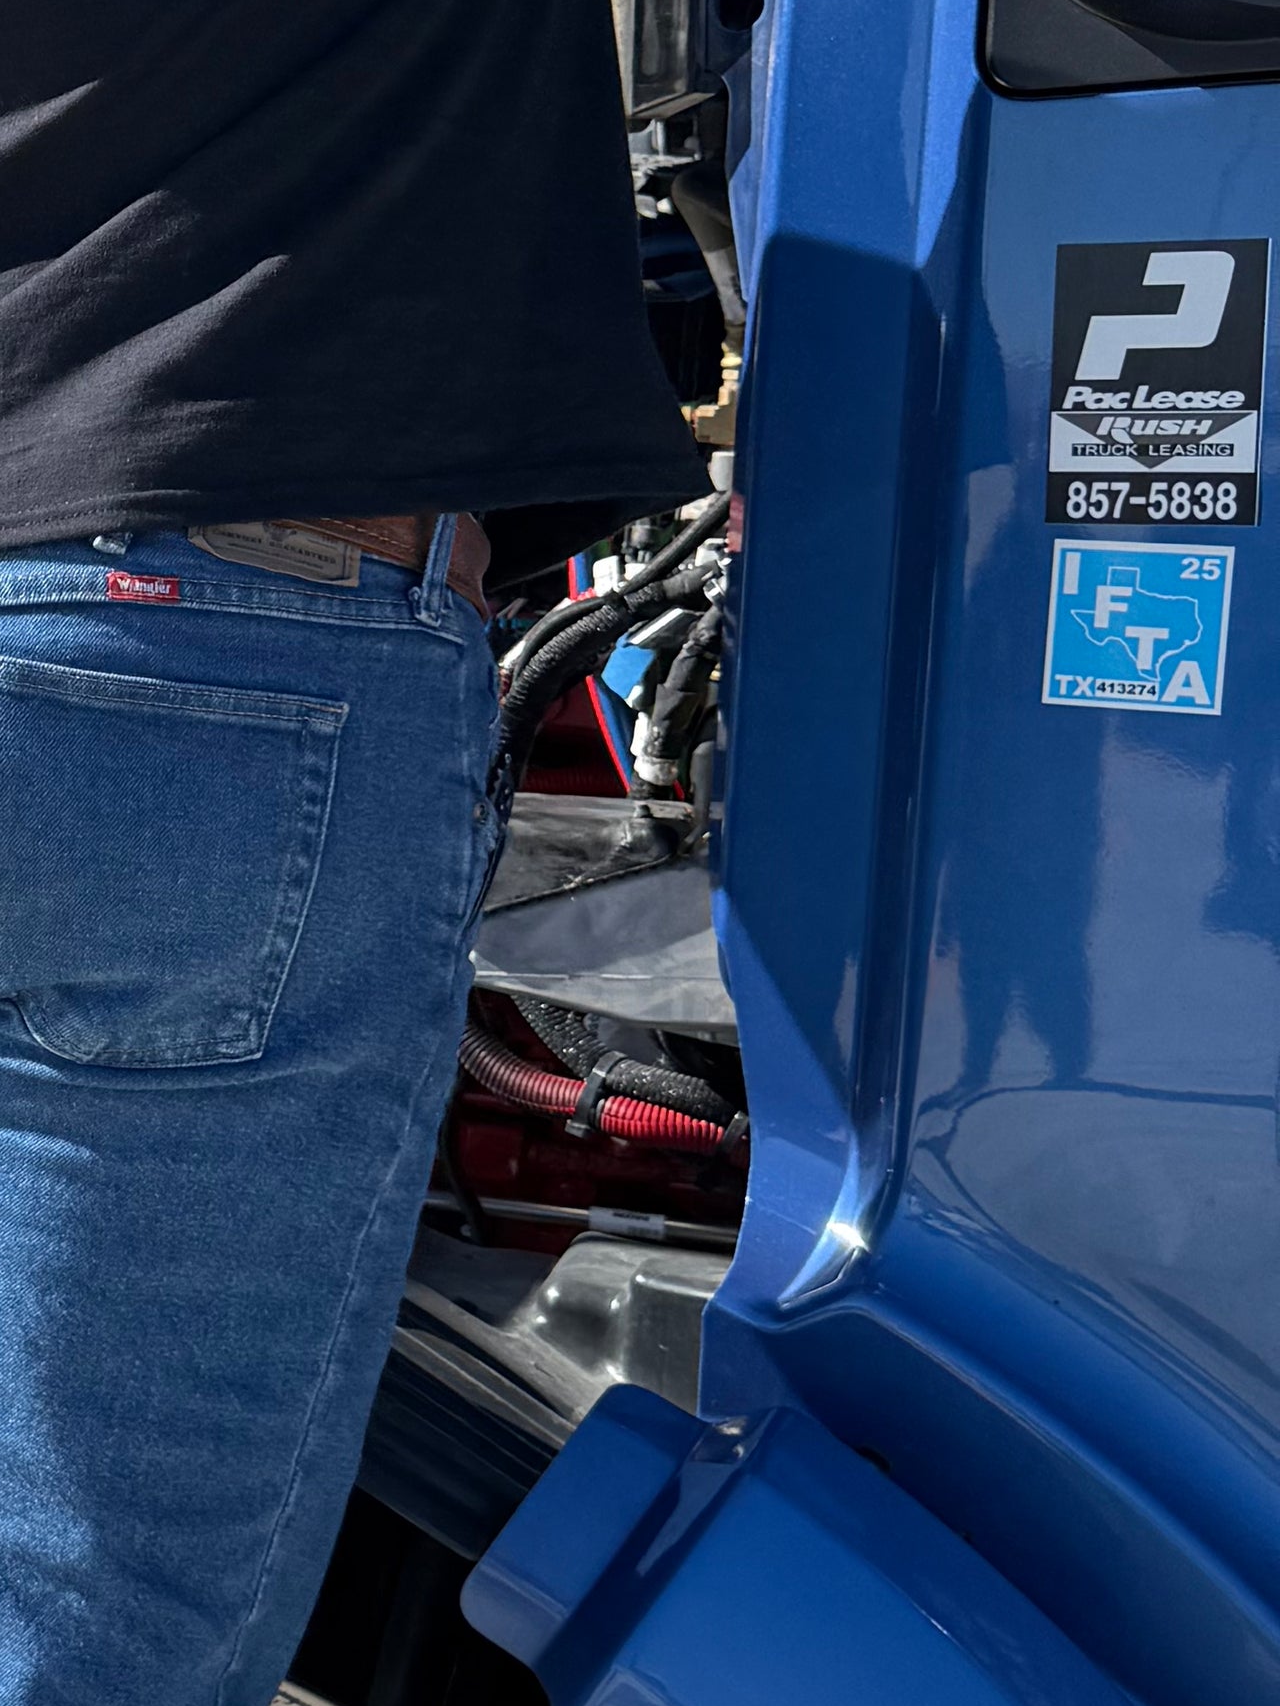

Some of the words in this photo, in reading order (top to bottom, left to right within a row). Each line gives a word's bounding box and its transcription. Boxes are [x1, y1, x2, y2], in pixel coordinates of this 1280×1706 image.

[1061, 385, 1246, 410] PacLease
[1073, 444, 1138, 456] TRUCK
[1148, 444, 1231, 456] LEASING
[1065, 480, 1238, 521] 857-5838
[1179, 557, 1221, 581] 25
[116, 577, 172, 596] Wrangler
[1054, 674, 1095, 697] TX
[1096, 681, 1157, 697] 413274
